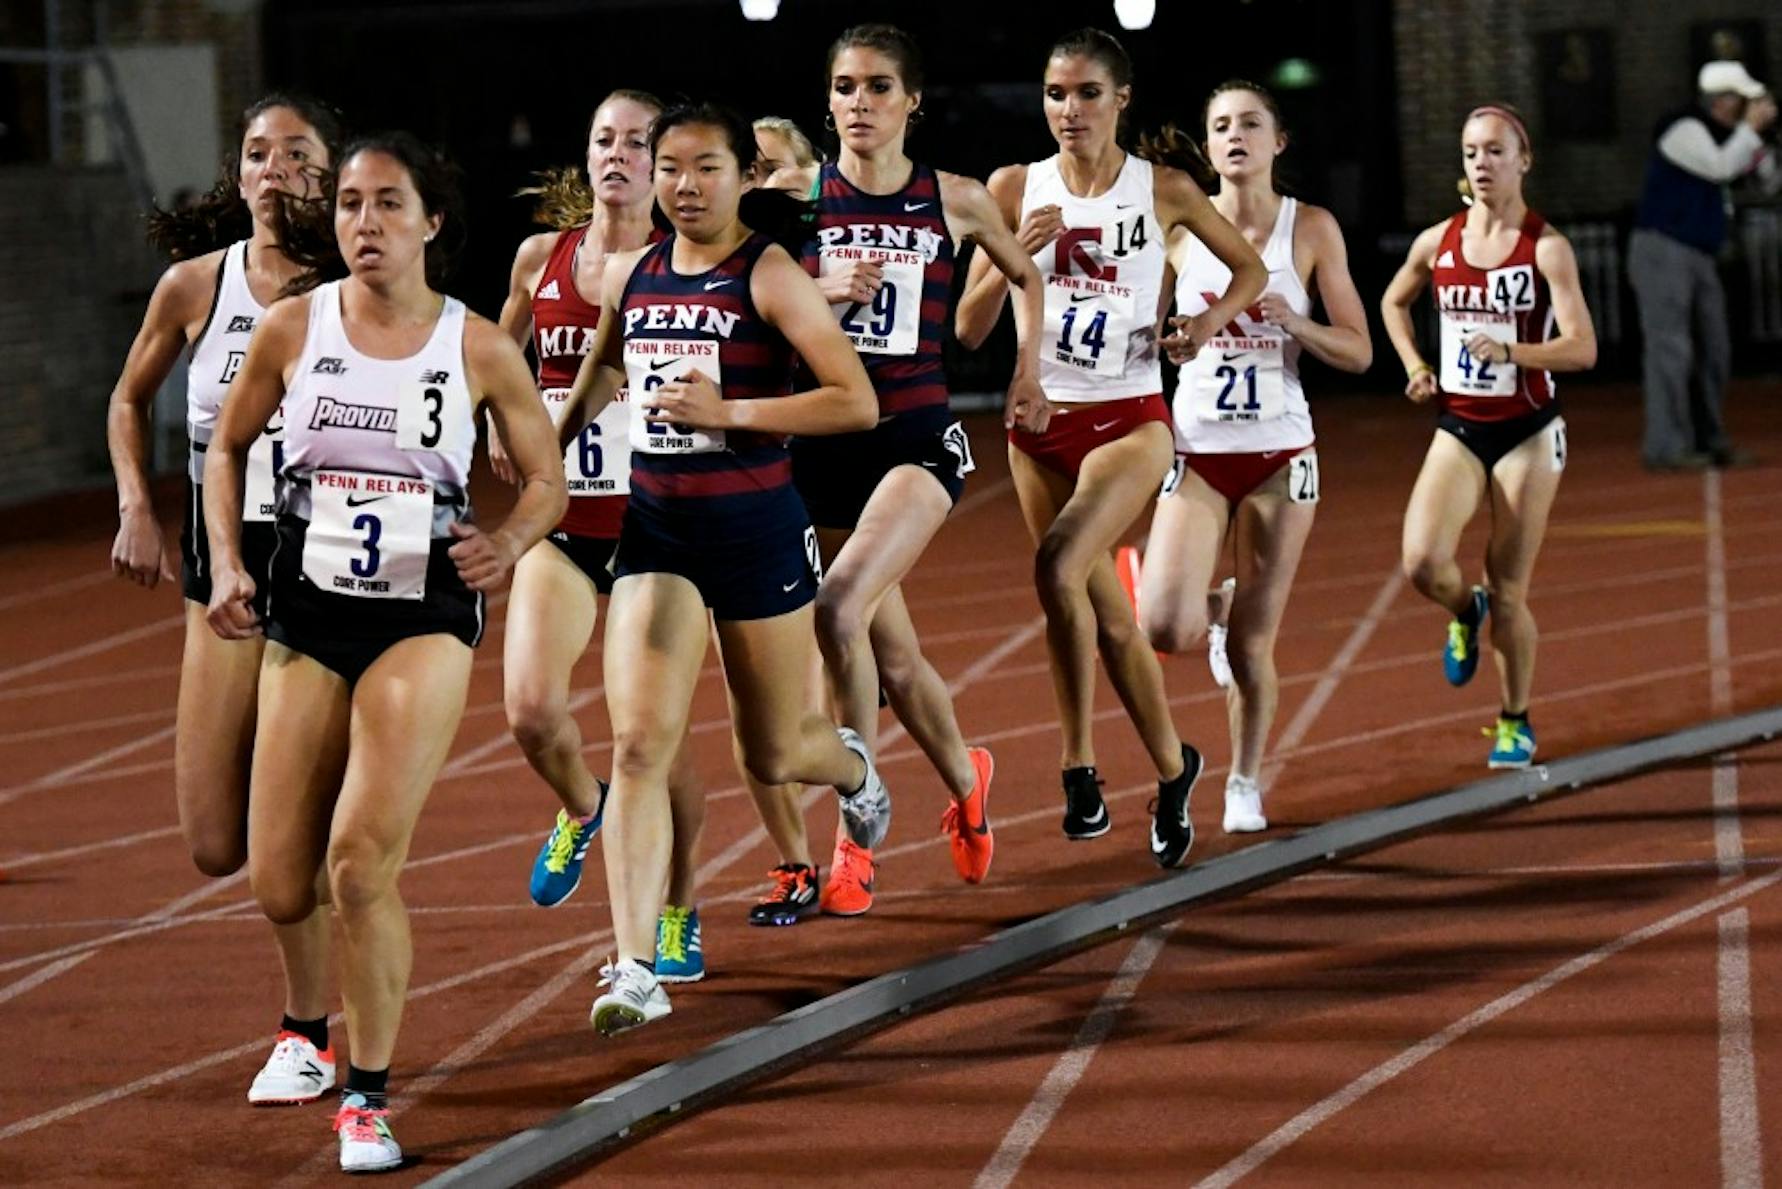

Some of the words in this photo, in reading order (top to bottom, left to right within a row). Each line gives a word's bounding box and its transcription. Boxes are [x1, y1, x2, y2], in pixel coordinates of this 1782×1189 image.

[820, 224, 944, 265] PENN
[1114, 214, 1148, 257] 14
[827, 248, 863, 260] PENN
[869, 251, 919, 265] RELAYS
[1049, 275, 1080, 290] PENN
[1085, 281, 1132, 298] RELAYS
[1495, 272, 1531, 306] 42
[623, 304, 741, 338] PENN
[1056, 307, 1108, 359] 14
[628, 342, 658, 354] PENN
[664, 343, 713, 356] RELAYS
[1215, 365, 1262, 411] 21
[308, 396, 398, 433] PROVID
[420, 387, 444, 448] 3
[578, 422, 603, 478] 6
[666, 437, 694, 448] POWER
[317, 474, 358, 489] PENN
[366, 478, 428, 495] RELAYS
[588, 480, 616, 490] POWER
[1299, 459, 1315, 500] 21
[350, 513, 382, 577] 3
[358, 580, 391, 592] POWER
